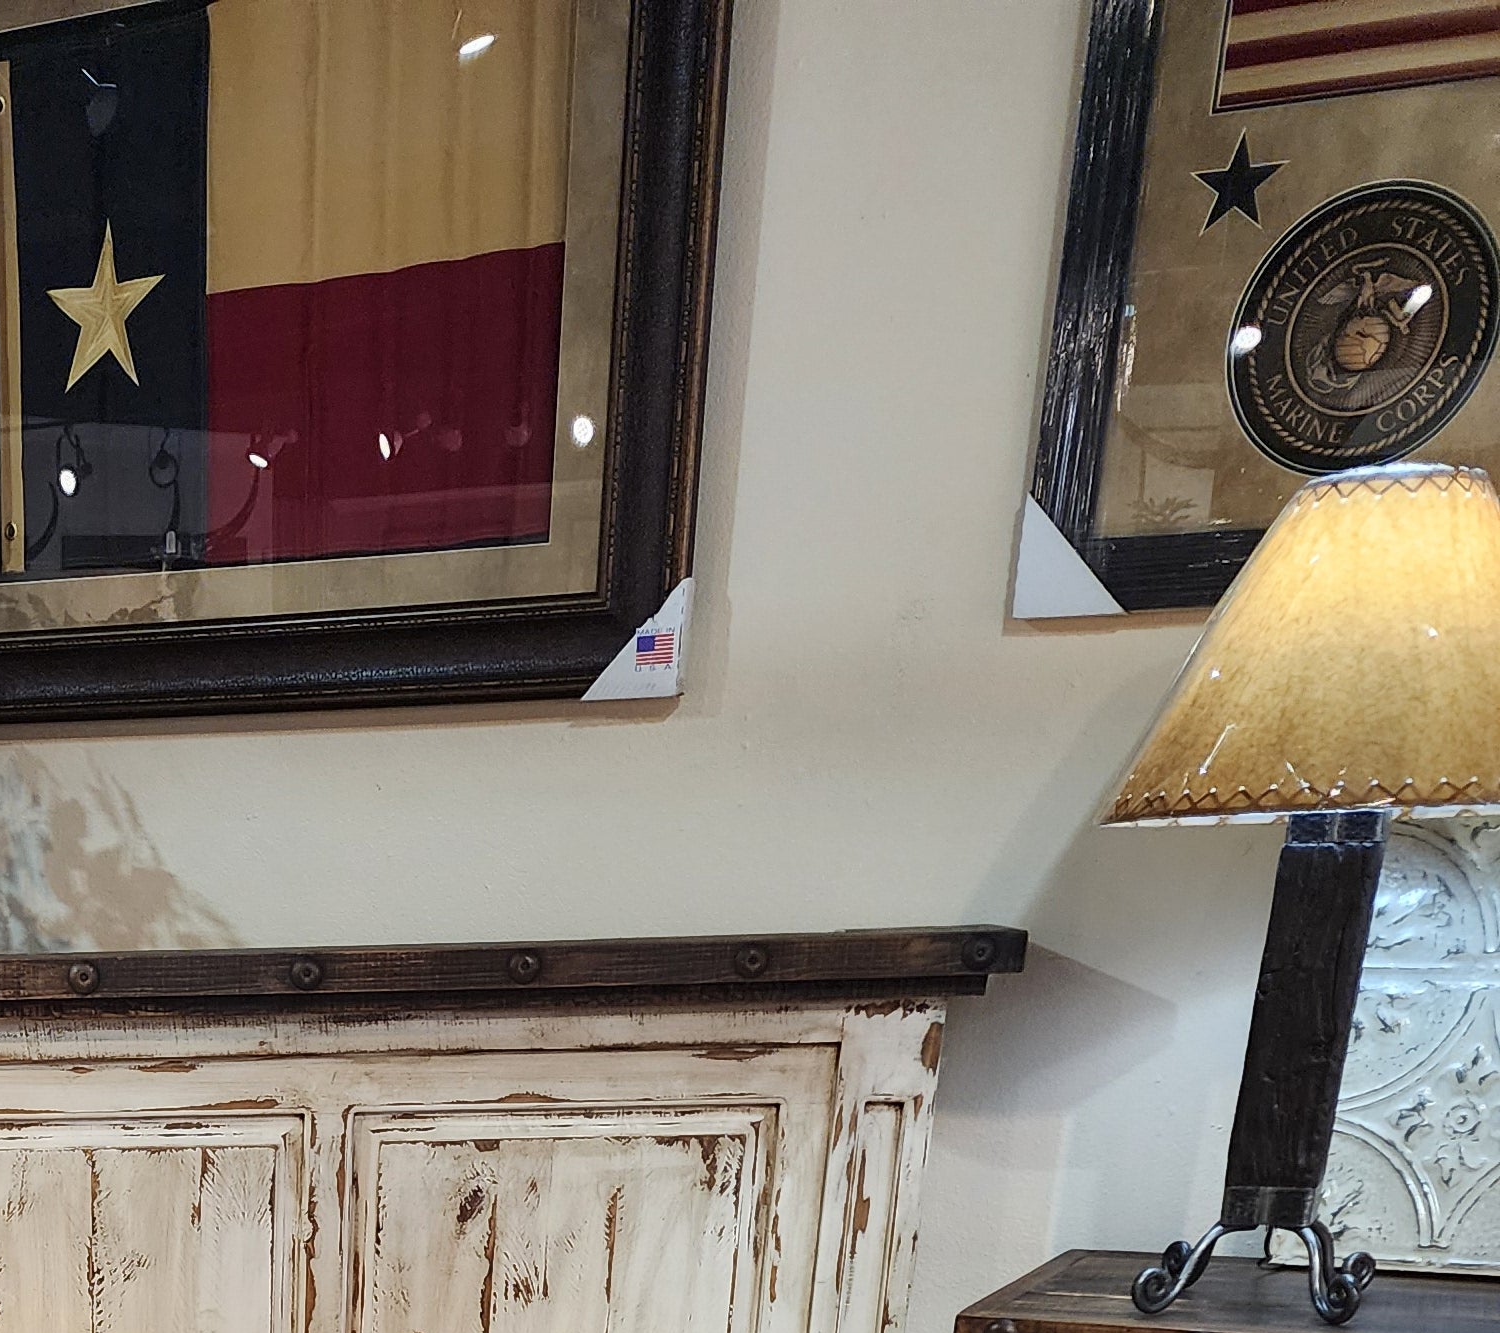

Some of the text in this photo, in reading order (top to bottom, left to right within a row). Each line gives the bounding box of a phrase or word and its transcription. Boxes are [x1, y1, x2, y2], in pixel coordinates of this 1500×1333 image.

[1268, 216, 1470, 326] UNITED STATES
[1266, 353, 1460, 444] MARINE CORPS
[665, 626, 675, 634] IN
